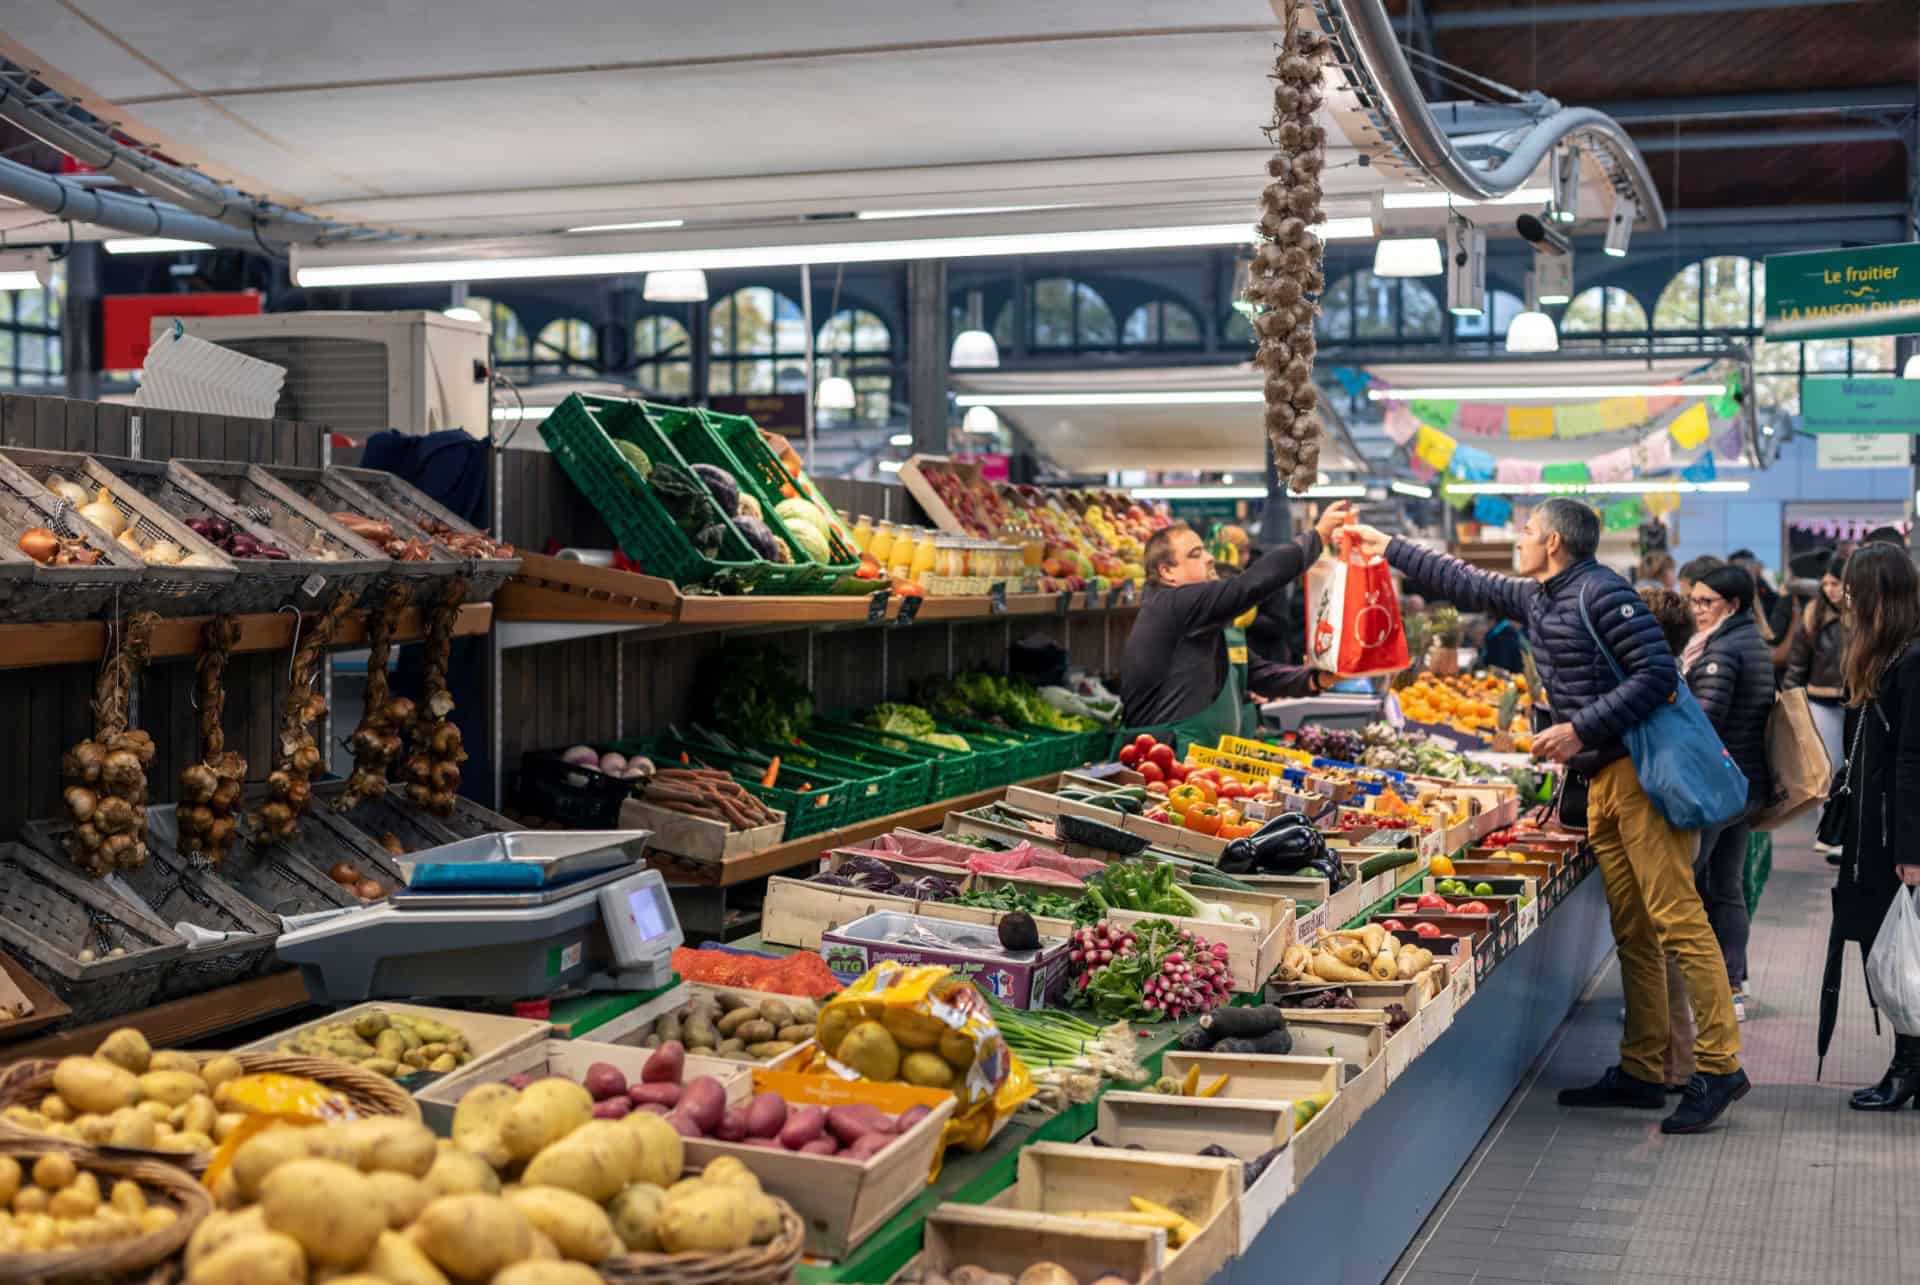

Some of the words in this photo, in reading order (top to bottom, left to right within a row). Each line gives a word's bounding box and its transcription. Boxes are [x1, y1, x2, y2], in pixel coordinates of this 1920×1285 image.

[1823, 269, 1842, 285] Le
[1846, 265, 1899, 283] fruitier
[1780, 306, 1800, 321] LA
[1804, 302, 1865, 320] MAISON
